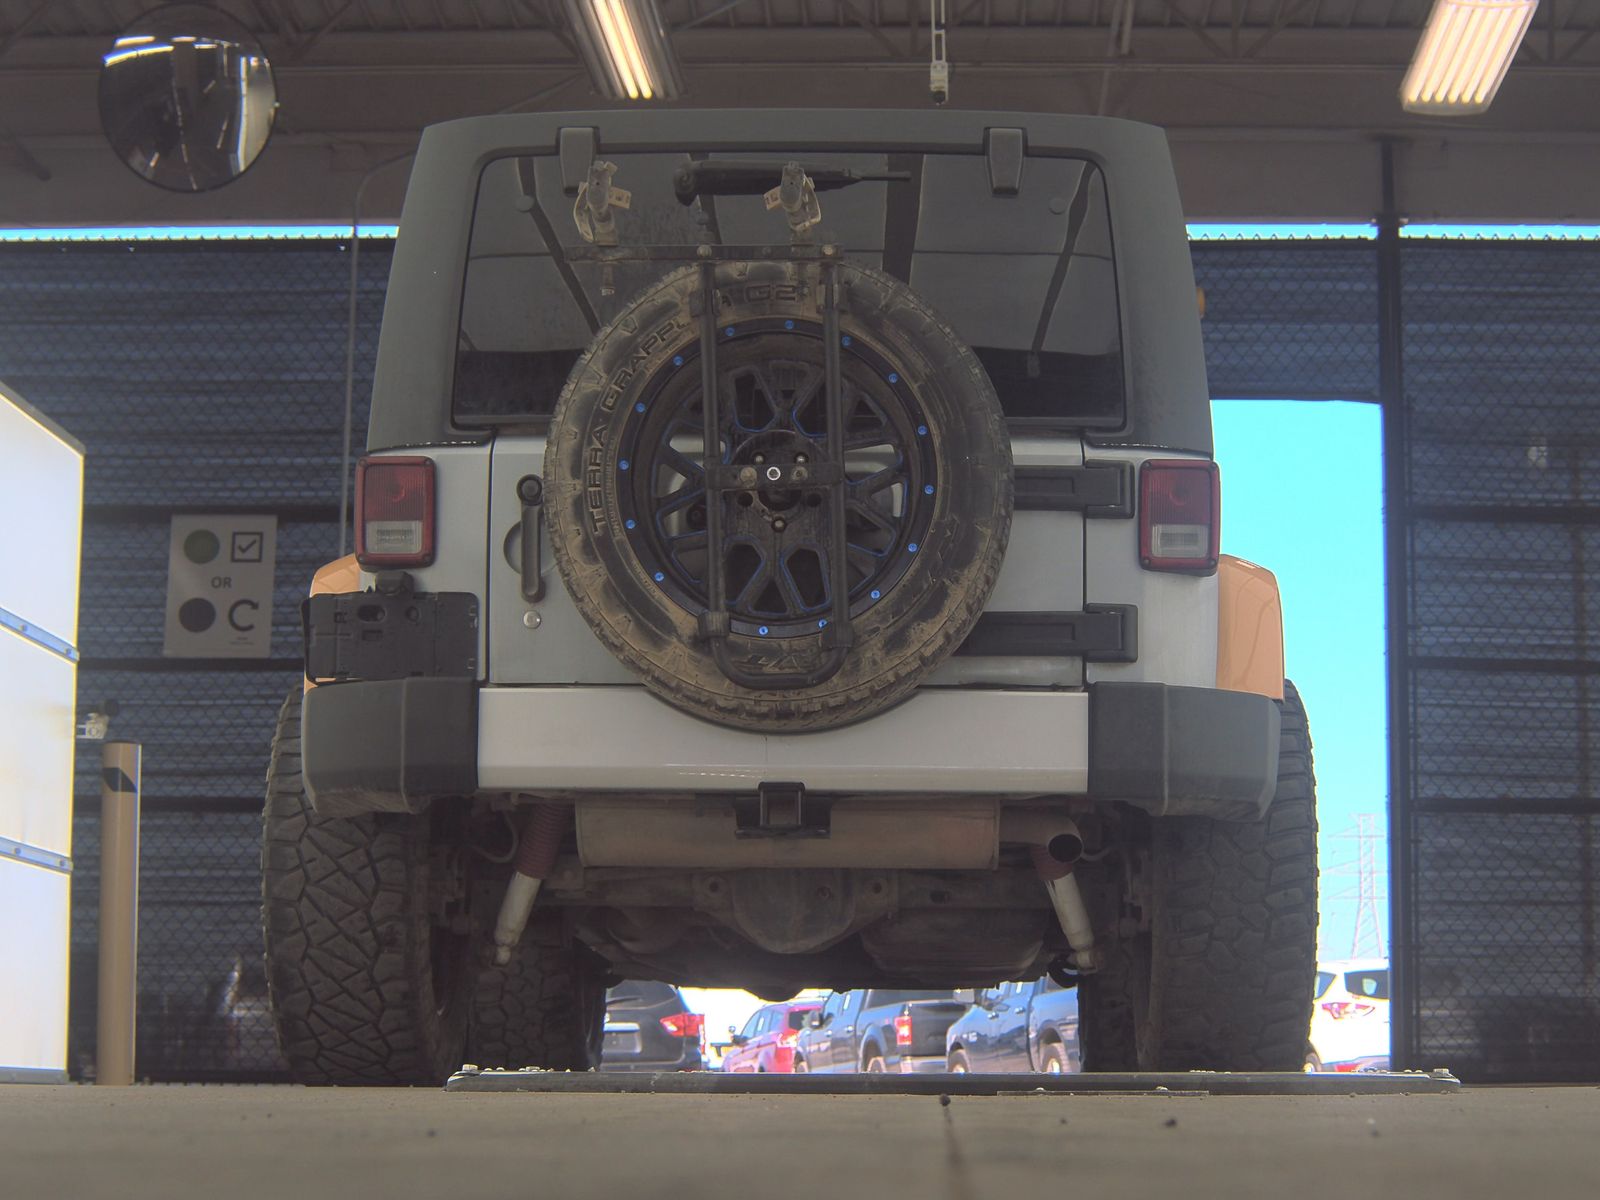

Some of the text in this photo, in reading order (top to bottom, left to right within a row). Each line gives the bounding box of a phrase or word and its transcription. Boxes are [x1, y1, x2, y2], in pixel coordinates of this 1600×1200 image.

[588, 424, 608, 535] TERRA
[746, 283, 797, 303] G2
[211, 576, 232, 589] OR
